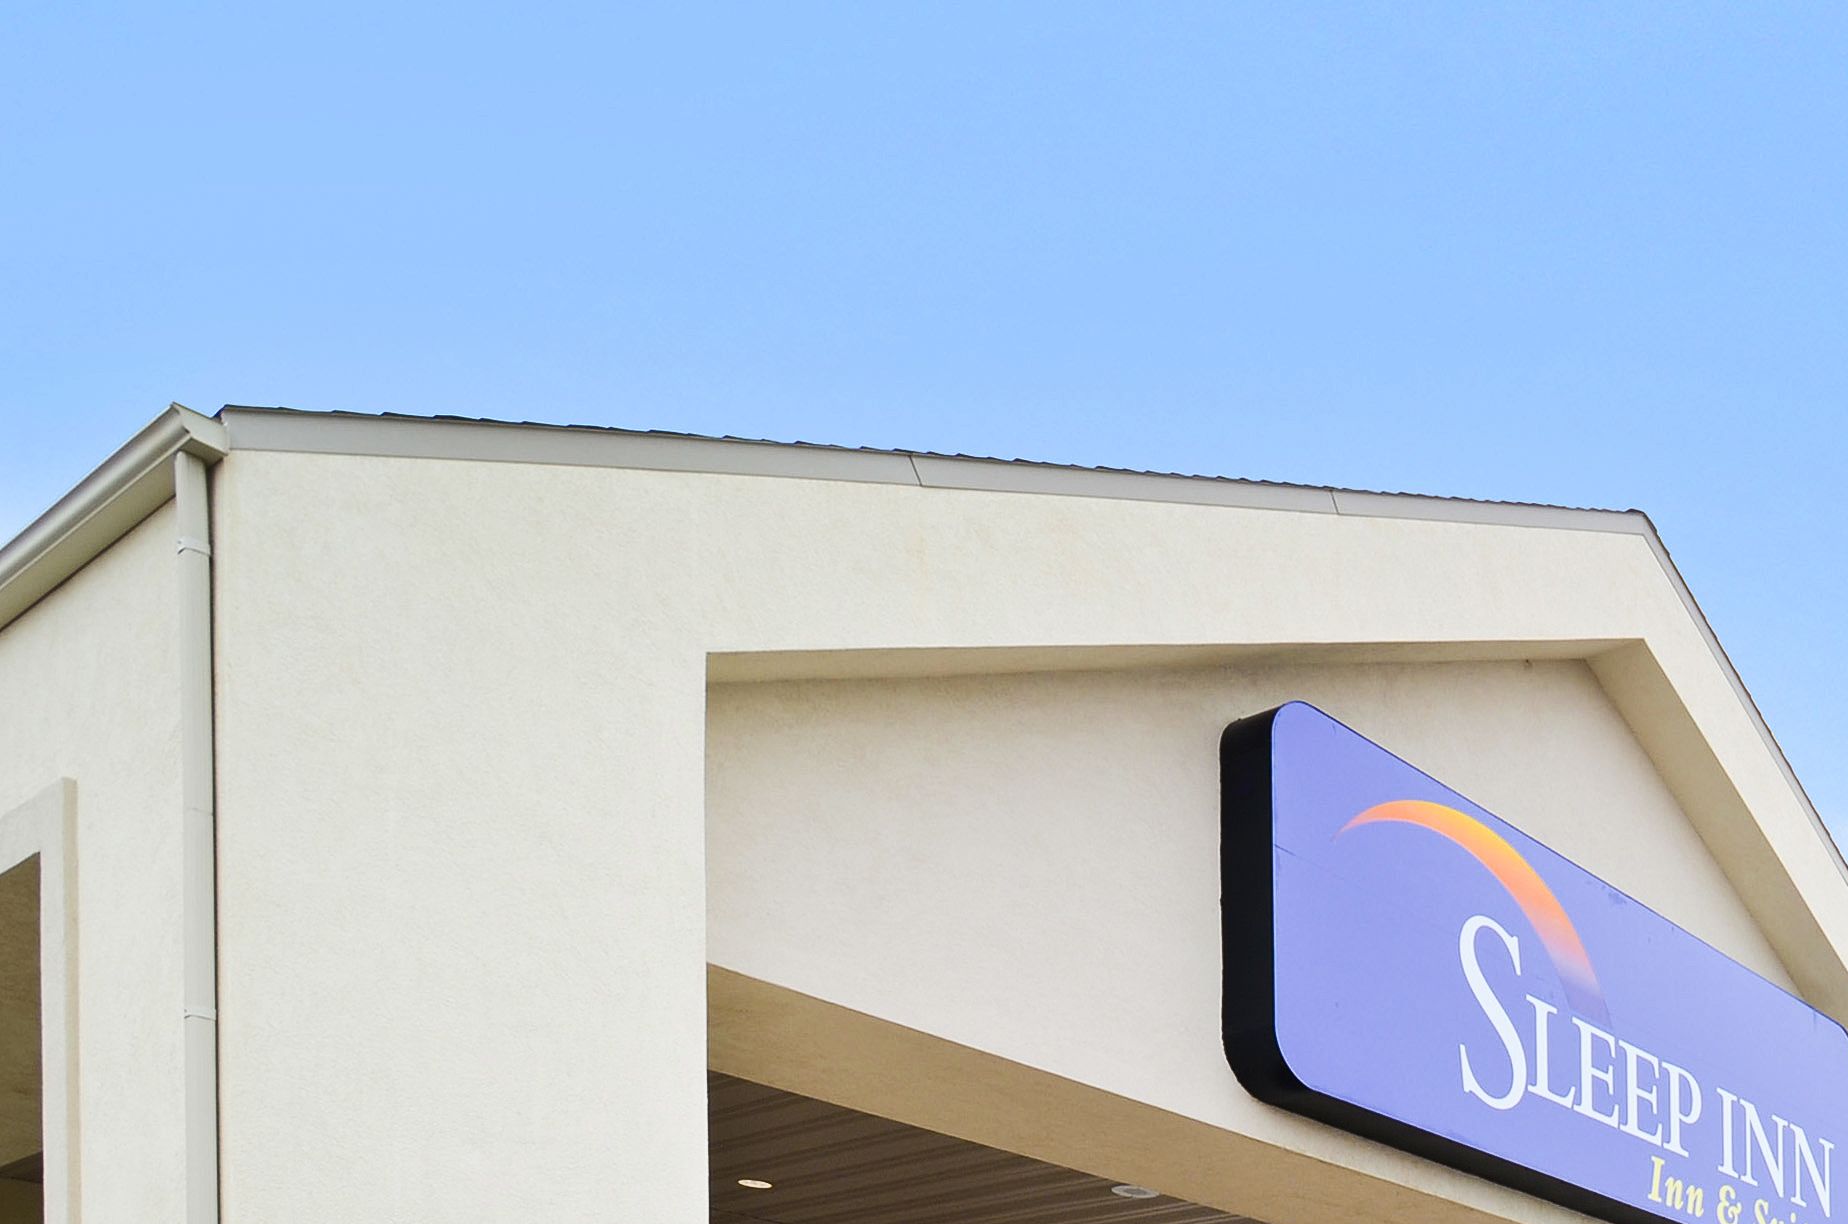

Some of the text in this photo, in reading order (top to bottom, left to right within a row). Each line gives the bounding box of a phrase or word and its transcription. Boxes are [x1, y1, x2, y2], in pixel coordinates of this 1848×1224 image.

[1459, 915, 1835, 1219] SLEEP INN
[1648, 1156, 1704, 1218] Inn
